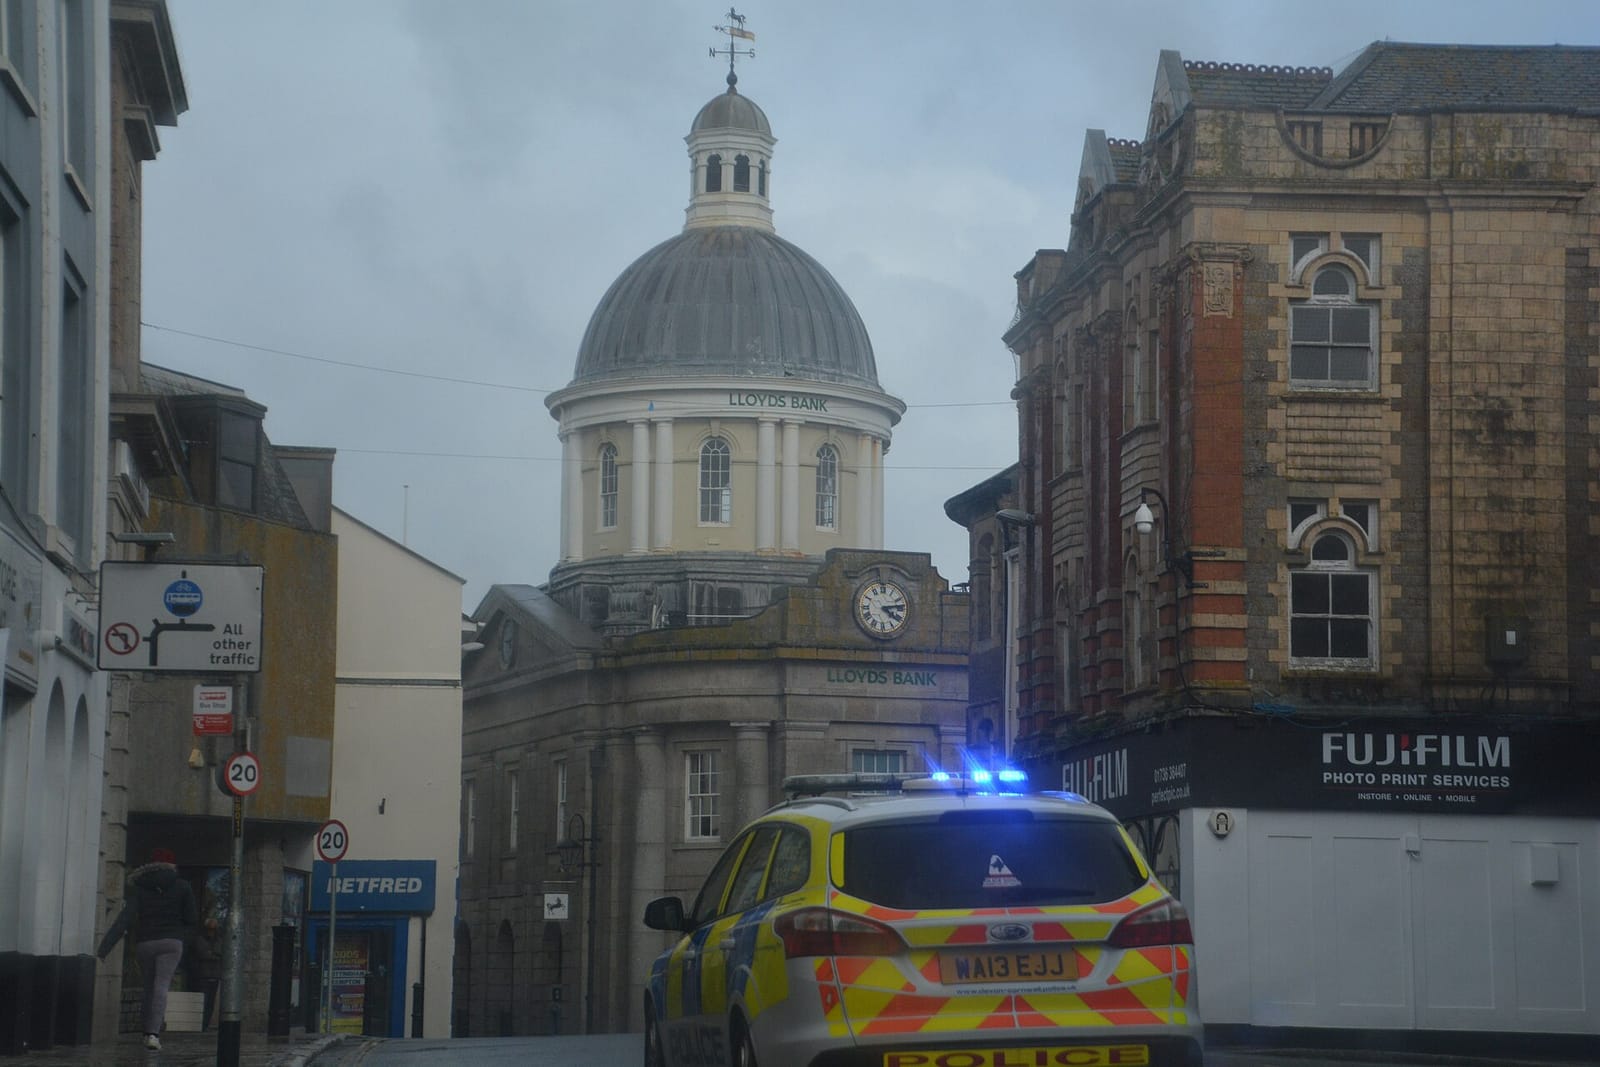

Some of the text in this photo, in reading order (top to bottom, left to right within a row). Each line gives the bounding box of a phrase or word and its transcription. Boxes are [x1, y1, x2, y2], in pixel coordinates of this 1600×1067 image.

[729, 393, 828, 412] LLOYDS BANK
[223, 623, 243, 635] All
[212, 639, 252, 650] other
[210, 652, 255, 665] traffic
[827, 668, 937, 686] LLOYDS BANK
[1322, 733, 1511, 767] FUJIFILM
[231, 763, 257, 782] 20
[1323, 772, 1510, 788] PHOTO PRINT SERVICES
[1357, 793, 1392, 801] INSTORE
[1403, 793, 1432, 801] ONLINE
[322, 832, 344, 849] 20
[955, 953, 1064, 979] WA13 EJJ
[888, 1047, 1145, 1067] POLICE
